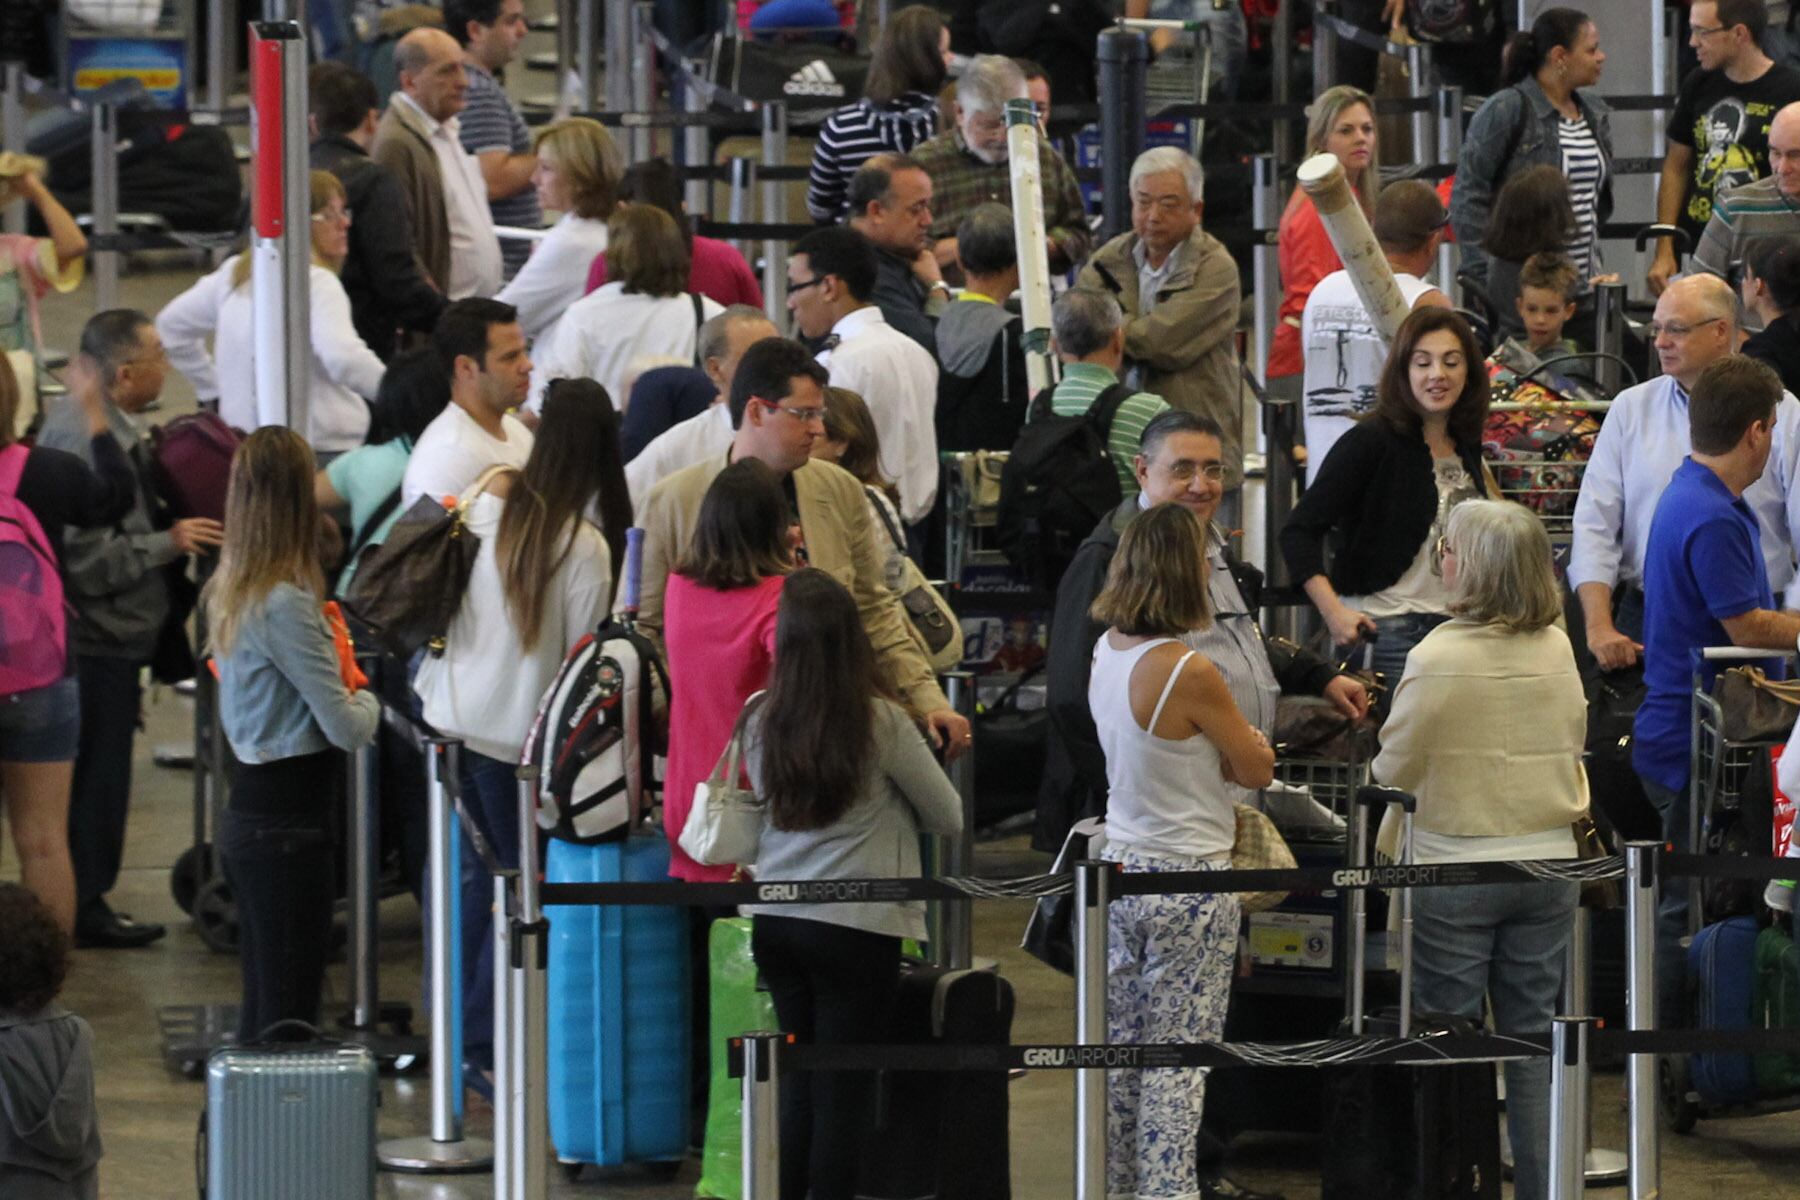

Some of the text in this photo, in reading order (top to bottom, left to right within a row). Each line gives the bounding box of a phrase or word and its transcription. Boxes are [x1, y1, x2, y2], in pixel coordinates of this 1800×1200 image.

[783, 81, 845, 97] adidas
[1332, 866, 1440, 887] GRUAIRPORT
[758, 881, 870, 901] GRUAIRPORT
[1023, 1047, 1141, 1066] GRUAIRPORT
